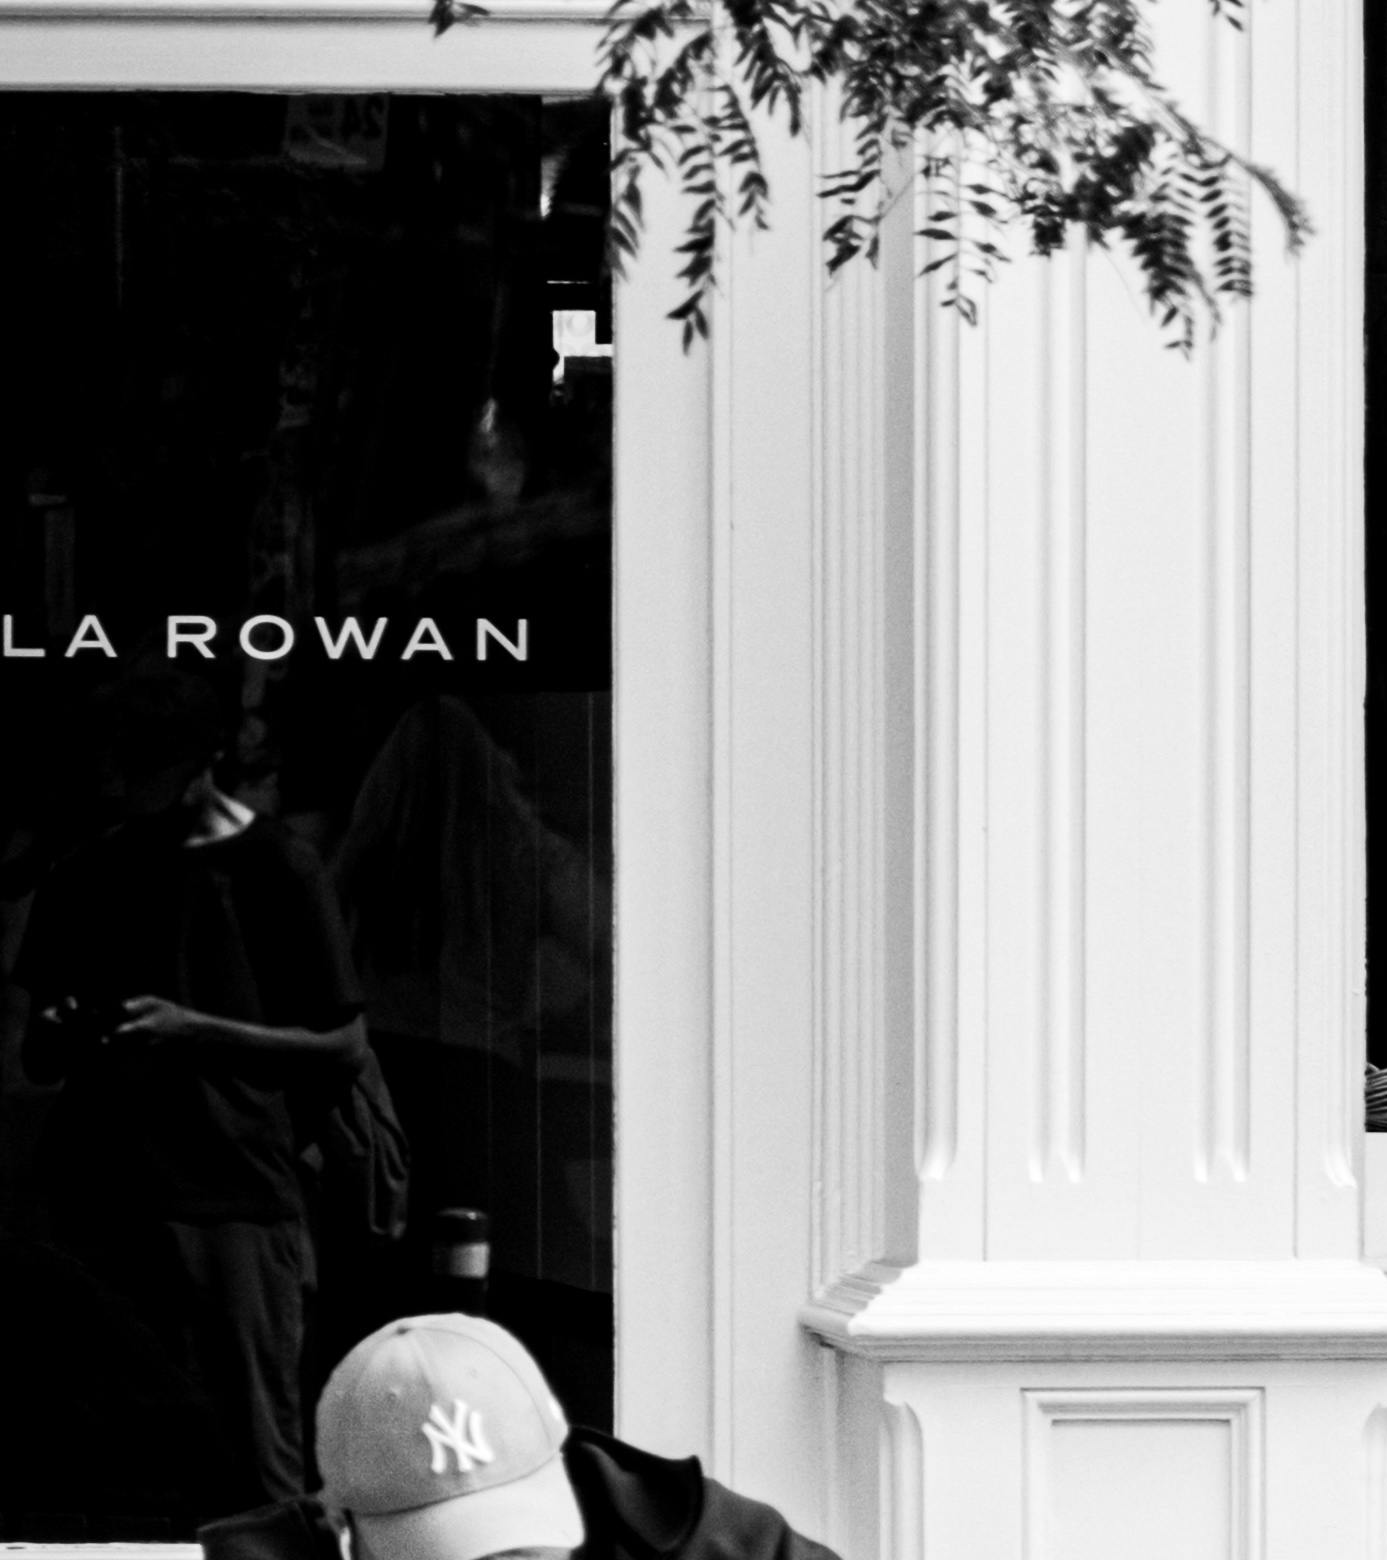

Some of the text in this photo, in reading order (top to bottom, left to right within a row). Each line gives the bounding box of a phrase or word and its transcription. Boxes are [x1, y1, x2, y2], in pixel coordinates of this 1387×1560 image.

[3, 614, 529, 661] LA ROWAN
[421, 1398, 496, 1475] NY
